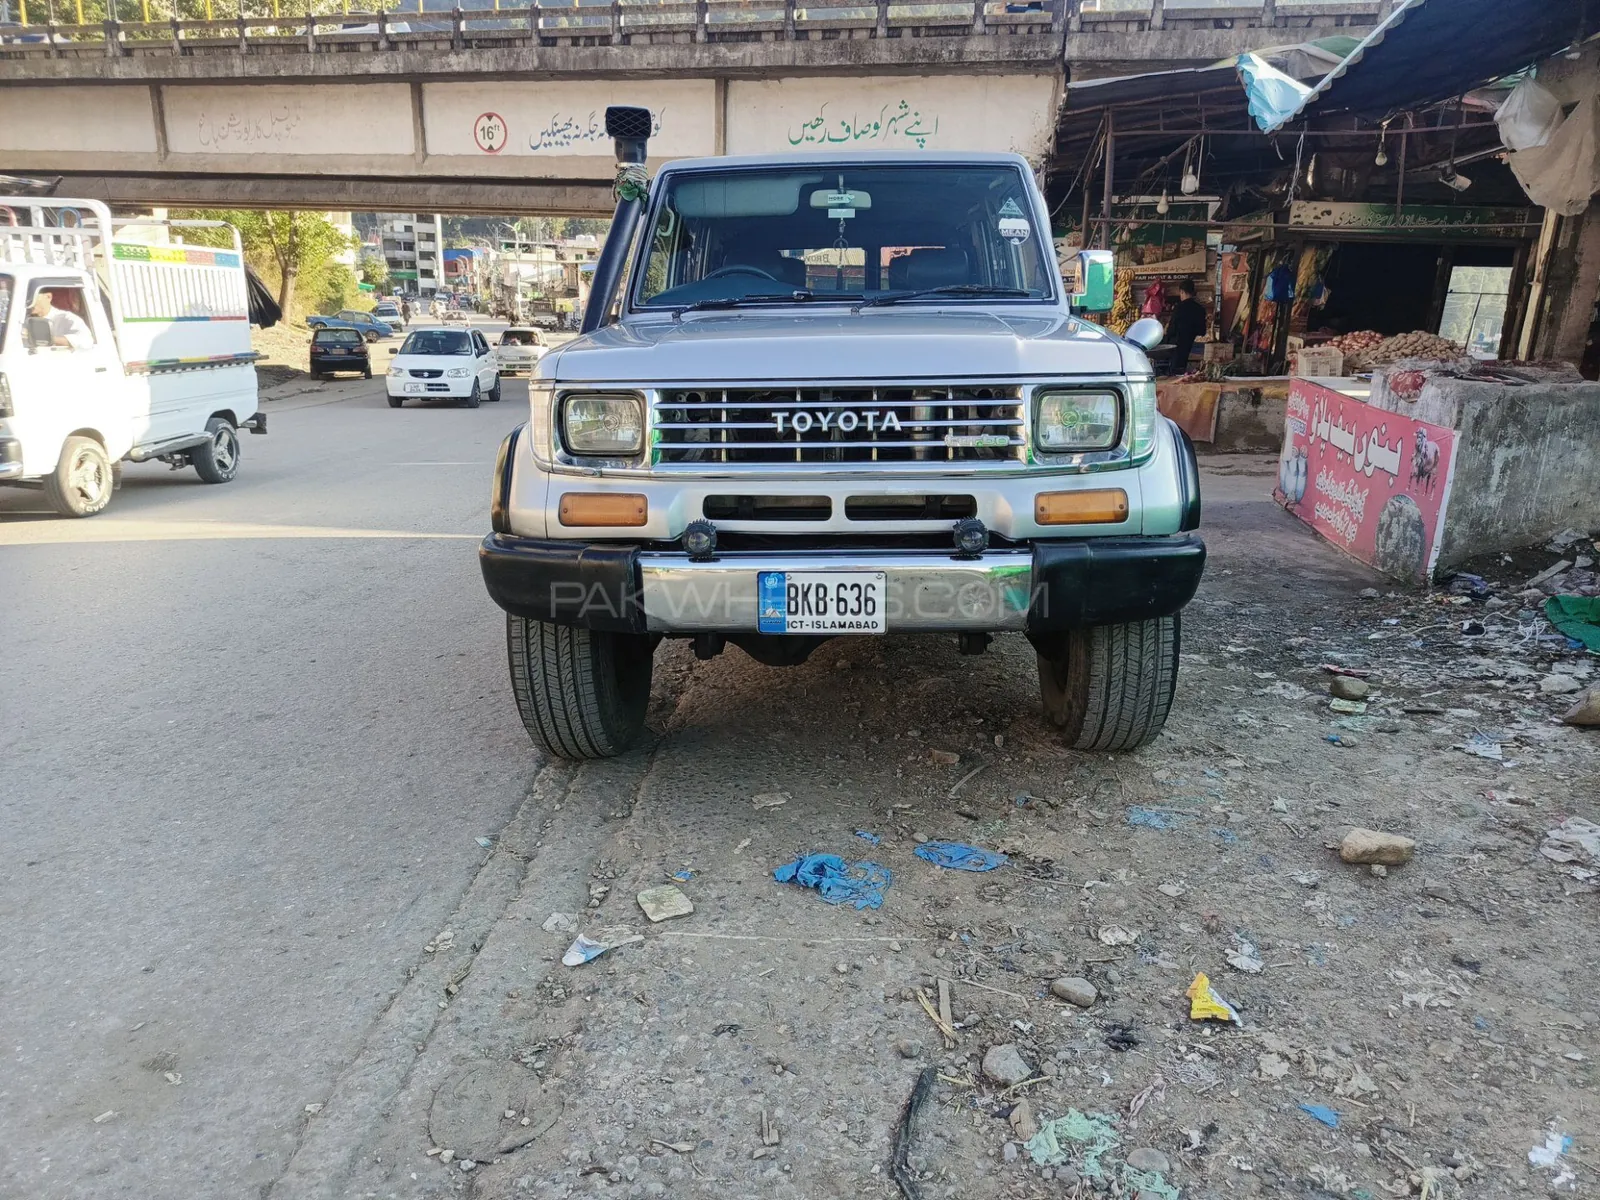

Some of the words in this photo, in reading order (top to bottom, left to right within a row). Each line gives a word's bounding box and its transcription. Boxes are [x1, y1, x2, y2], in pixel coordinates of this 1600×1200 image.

[529, 112, 574, 150] پھینکیں
[788, 102, 829, 145] رکھیں
[827, 113, 871, 143] صاف
[869, 104, 888, 139] کو
[883, 99, 909, 142] شہر
[904, 111, 939, 149] اپنے
[771, 410, 902, 434] TOYOTA
[1354, 424, 1403, 487] بنوں
[787, 620, 879, 629] ICT-ISLAMABAD
